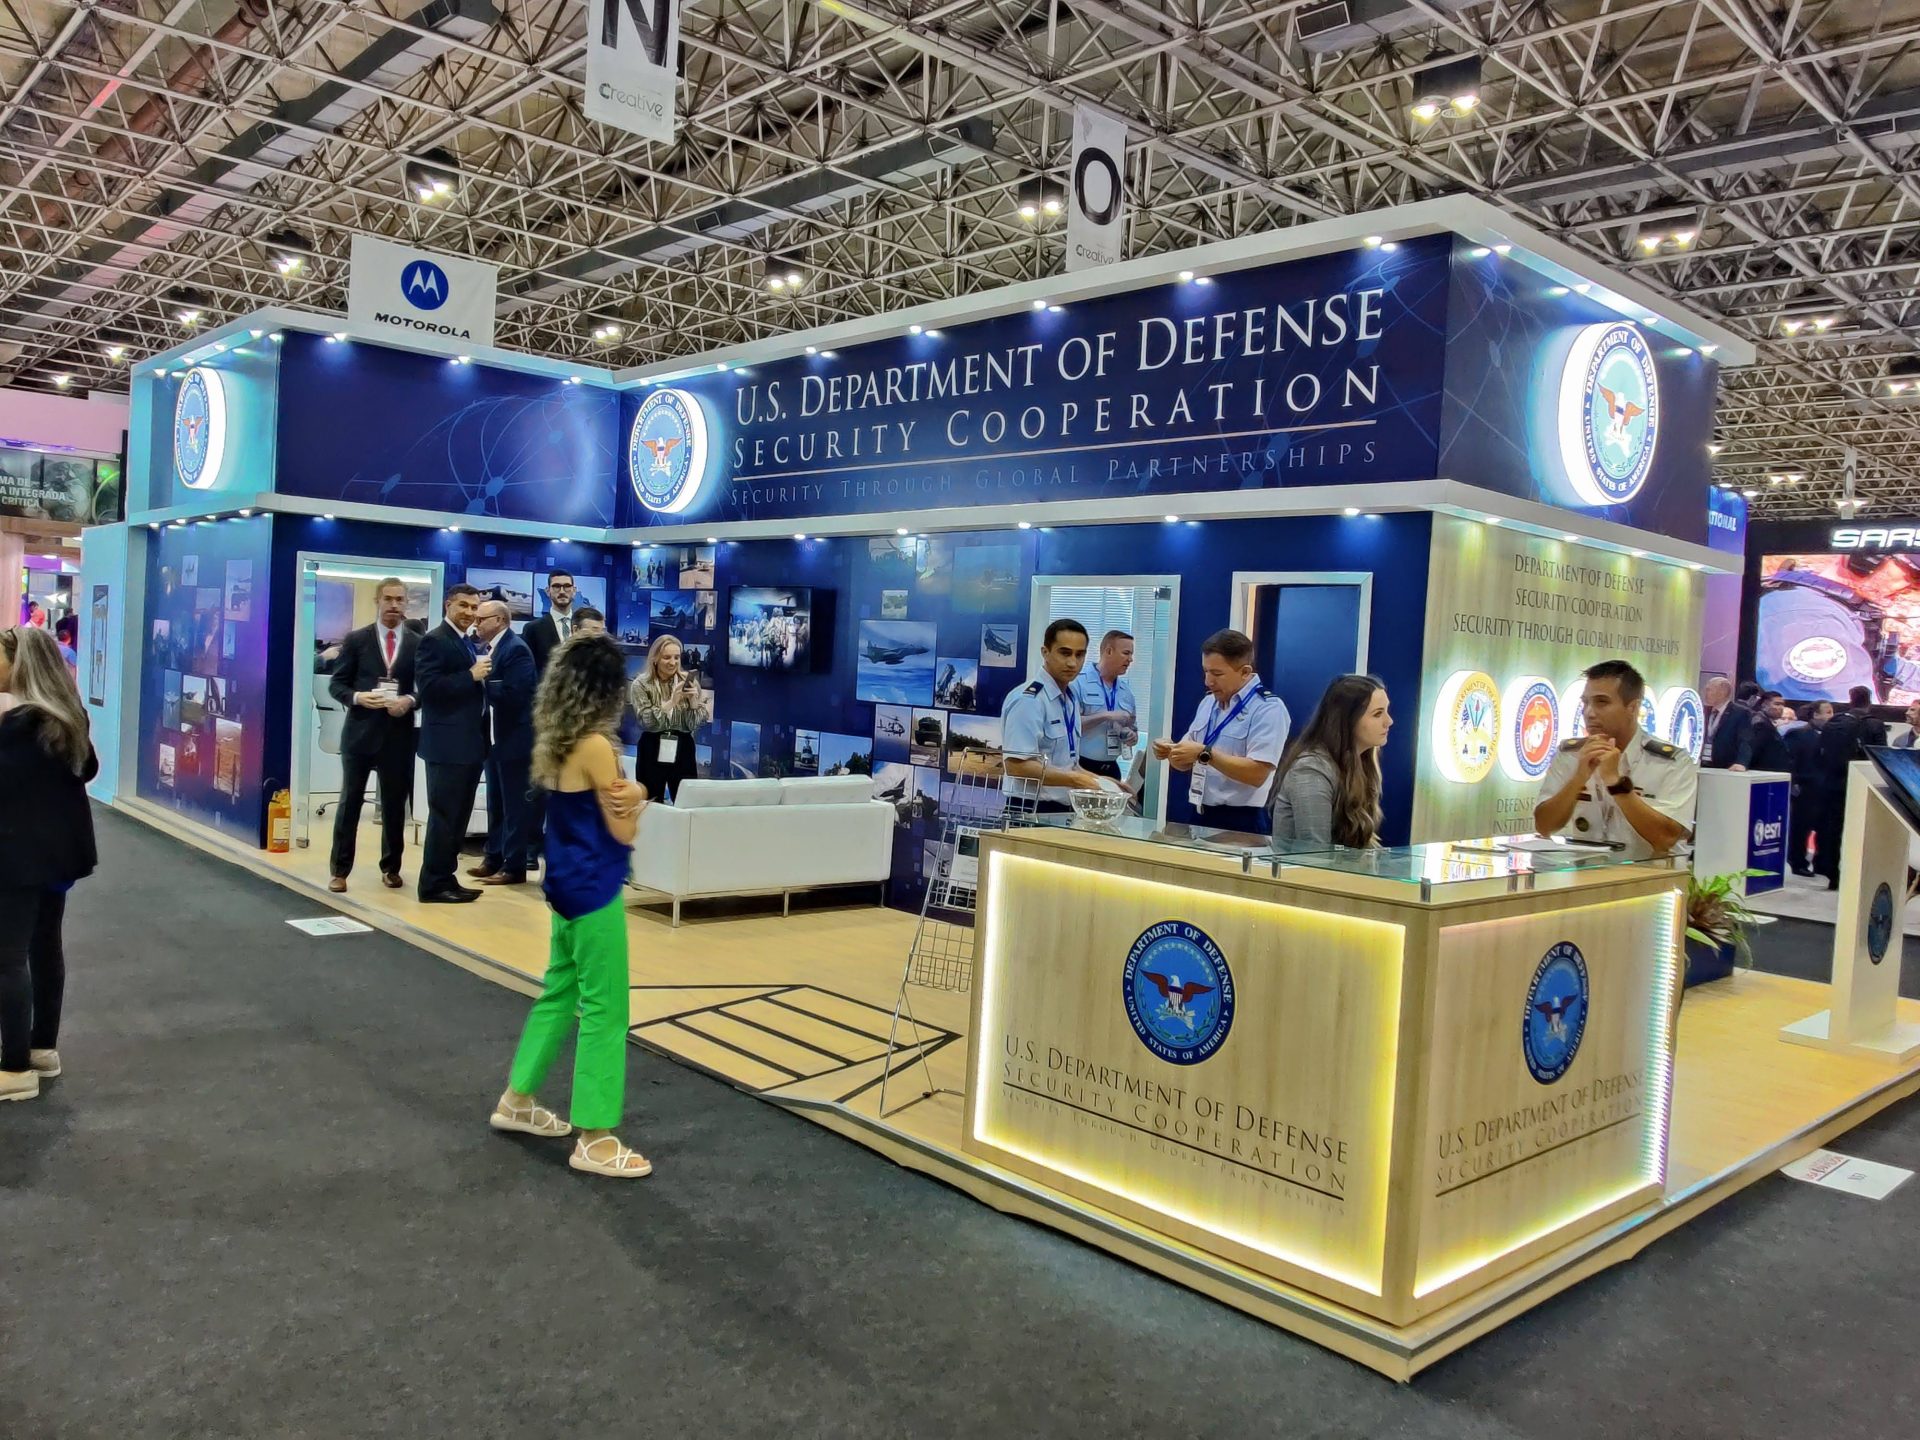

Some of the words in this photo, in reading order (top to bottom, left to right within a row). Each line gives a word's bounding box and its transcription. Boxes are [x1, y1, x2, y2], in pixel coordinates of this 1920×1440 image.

[1075, 147, 1122, 226] O
[374, 312, 471, 340] MOTOROLA
[736, 381, 787, 426] U.S.
[800, 344, 1043, 417] DEPARTMENT
[1057, 332, 1116, 381] OF
[1137, 288, 1385, 371] DEFENSE
[733, 421, 916, 469] SECURITY
[947, 365, 1381, 447] COOPERATION
[9, 487, 66, 501] INTEGRADA
[730, 484, 824, 506] SECURITY
[841, 475, 952, 498] THROUGH
[976, 466, 1079, 489] GLOBAL
[1108, 441, 1376, 481] PARTNERSHIPS
[1831, 528, 1920, 548] SAA
[1514, 553, 1587, 585] DEPARTMENT
[1588, 570, 1601, 586] OF
[1604, 572, 1644, 595] DEFENSE
[1515, 588, 1570, 612] SECURITY
[1571, 597, 1643, 622] COOPERATION
[1453, 613, 1514, 638] SECURITY
[1517, 620, 1574, 645] THROUGH
[1576, 628, 1614, 649] GLOBAL
[1617, 634, 1680, 656] PARTNERSHIPS
[1765, 815, 1781, 840] esri
[1125, 923, 1179, 980] DEPARTMENT
[1184, 927, 1201, 940] OF
[1202, 940, 1232, 1004] DEFENSE
[1127, 996, 1147, 1036] UNITED
[1147, 1036, 1178, 1059] STATES
[1182, 1051, 1194, 1060] OF
[1199, 1019, 1228, 1056] AMERICA
[1003, 1061, 1116, 1113] SECURITY
[1134, 1103, 1346, 1192] COOPERATION
[1005, 1034, 1038, 1064] U.S.
[1048, 1047, 1187, 1111] DEPARTMENT
[1195, 1096, 1225, 1122] OF
[1235, 1104, 1349, 1166] DEFENSE
[1438, 1127, 1468, 1160] U.S.
[1474, 1093, 1569, 1147] DEPARTMENT
[1570, 1088, 1589, 1109] OF
